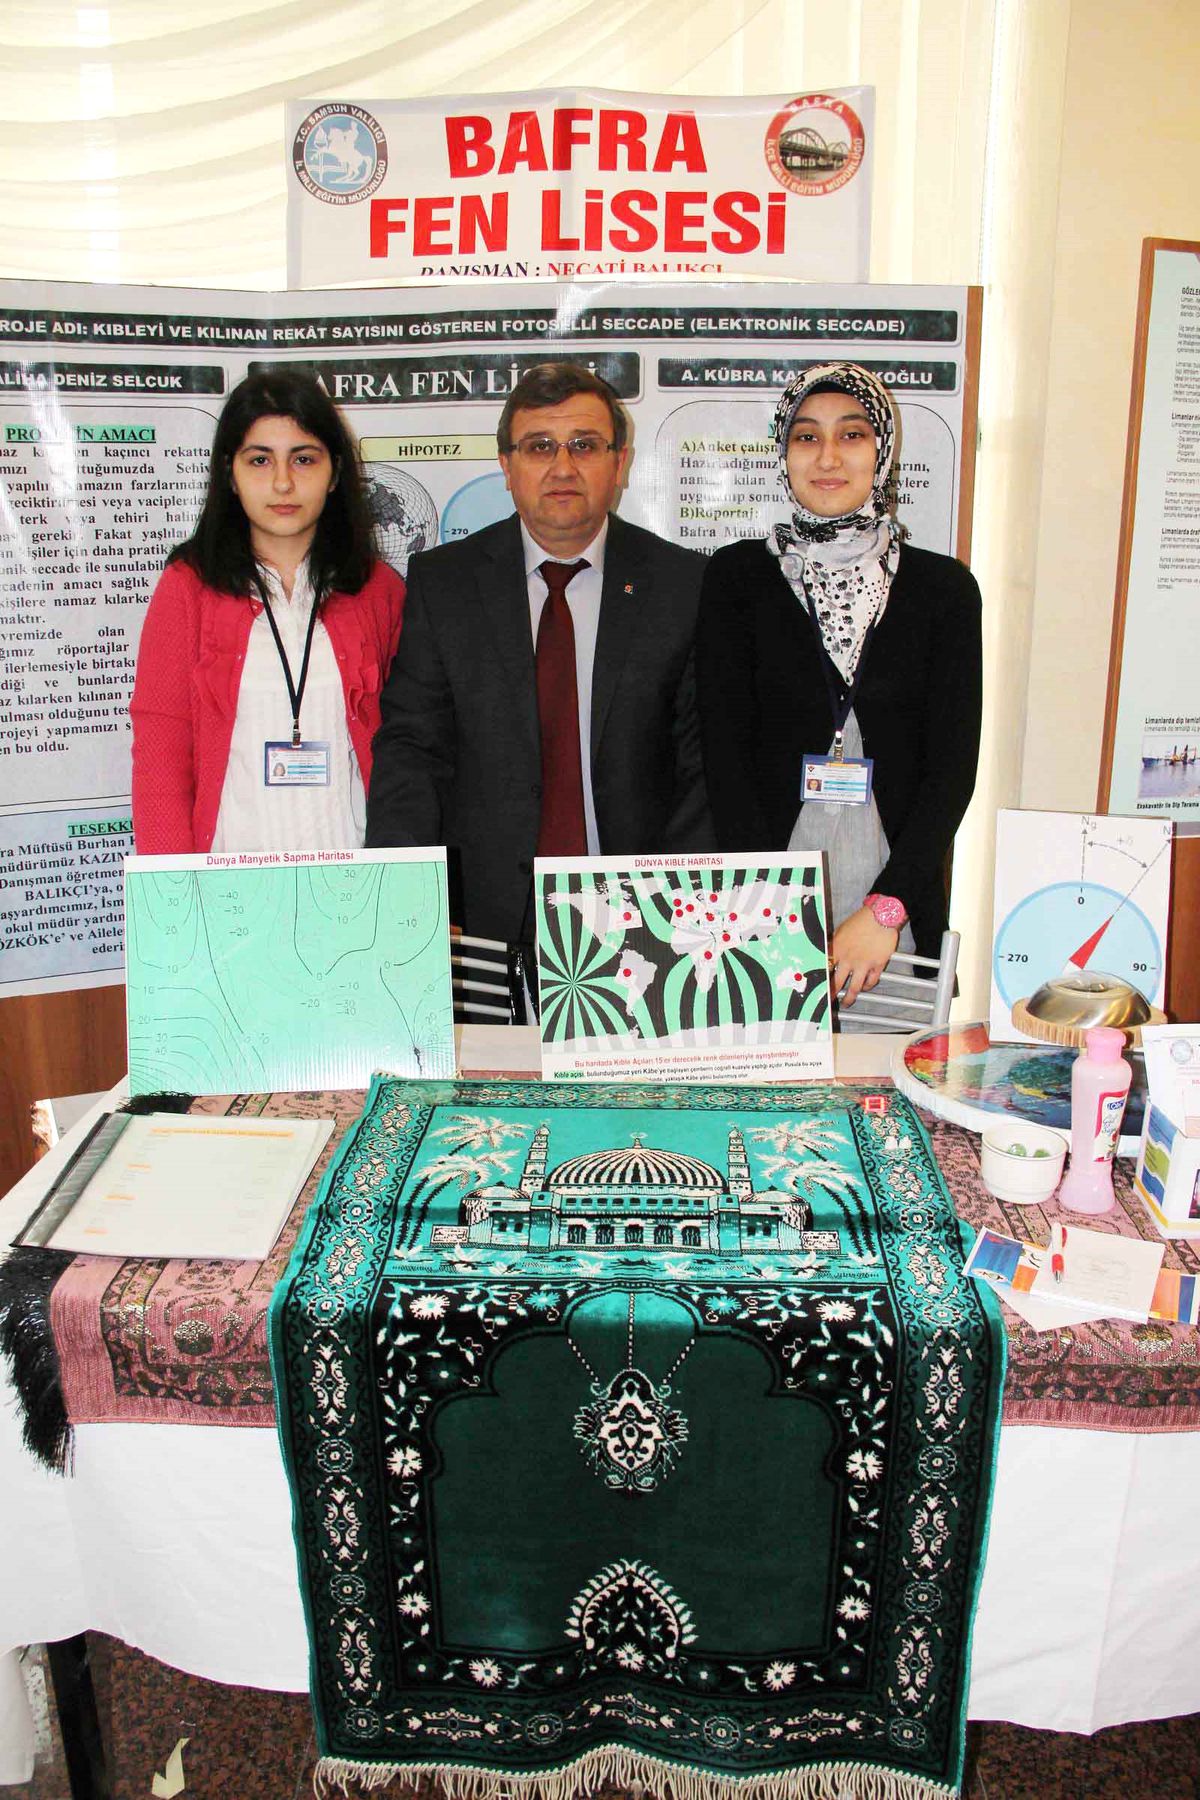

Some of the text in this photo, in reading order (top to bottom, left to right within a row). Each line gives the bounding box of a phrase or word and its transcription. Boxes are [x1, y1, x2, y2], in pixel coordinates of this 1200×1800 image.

[445, 108, 708, 178] BAFRA
[369, 191, 509, 258] FEN
[52, 321, 88, 335] ADI:
[93, 322, 164, 337] KIBLEYİ
[169, 325, 192, 338] VE
[197, 325, 267, 340] KILINAN
[273, 326, 327, 340] REKÂT
[332, 325, 403, 338] SAYISINI
[408, 320, 496, 336] GÖSTEREN
[602, 318, 685, 330] SECCADE
[690, 316, 811, 332] (ELEKTRONİK
[816, 319, 905, 333] SECCADE)
[54, 372, 107, 386] DENİZ
[681, 367, 767, 381] A. KÜBRA
[410, 370, 475, 396] FEN
[100, 428, 156, 440] AMACI
[104, 446, 150, 460] kaçıncı
[398, 443, 462, 457] HİPOTEZ
[102, 499, 132, 510] veya
[19, 512, 149, 525] terk tehiri
[94, 528, 133, 541] Fakat
[450, 528, 469, 536] 270
[92, 545, 124, 557] daha
[128, 544, 168, 559] pratik
[85, 562, 101, 573] ile
[63, 581, 103, 591] amacı
[111, 576, 150, 591] sağlık
[54, 596, 97, 607] namaz
[97, 626, 126, 638] olan
[57, 641, 130, 658] röportajlar
[45, 679, 59, 688] ve
[18, 690, 122, 706] kılarken kılınan
[48, 706, 109, 721] olduğunu
[46, 723, 118, 739] yapmamızı
[16, 740, 70, 754] bu oldu.
[18, 843, 73, 856] Müftüsü
[77, 838, 125, 851] Burhan
[239, 853, 281, 866] Manyetik
[283, 852, 316, 863] Sapma
[318, 850, 354, 861] Haritası
[665, 856, 686, 867] KIBLE
[343, 869, 356, 878] 30
[168, 897, 179, 907] 30
[340, 893, 352, 902] 20
[1077, 896, 1085, 905] 0
[5, 917, 81, 935] okul müdür
[338, 916, 349, 925] 10
[69, 933, 84, 942] ve
[1007, 953, 1147, 972] 270 90
